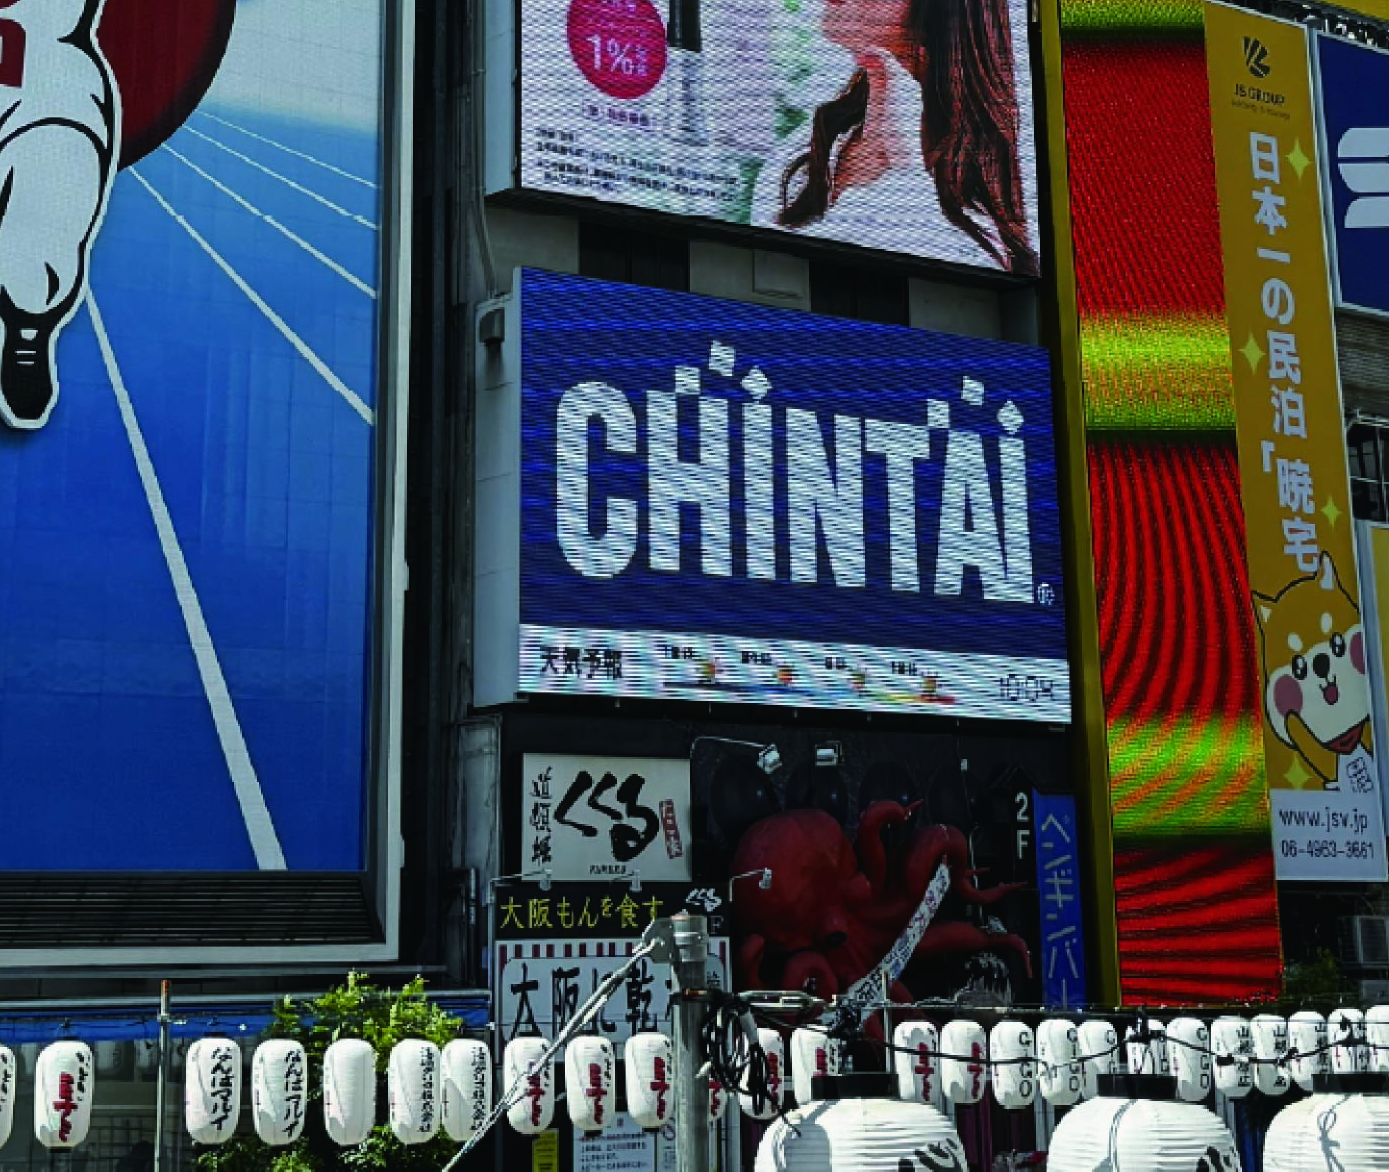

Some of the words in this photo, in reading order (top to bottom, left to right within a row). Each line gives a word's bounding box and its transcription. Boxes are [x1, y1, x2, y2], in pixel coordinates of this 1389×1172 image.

[557, 340, 1035, 604] CHINTAI
[553, 770, 660, 862] くくる
[500, 895, 664, 929] 大阪もんを食す
[511, 958, 673, 1033] 大阪に乾
